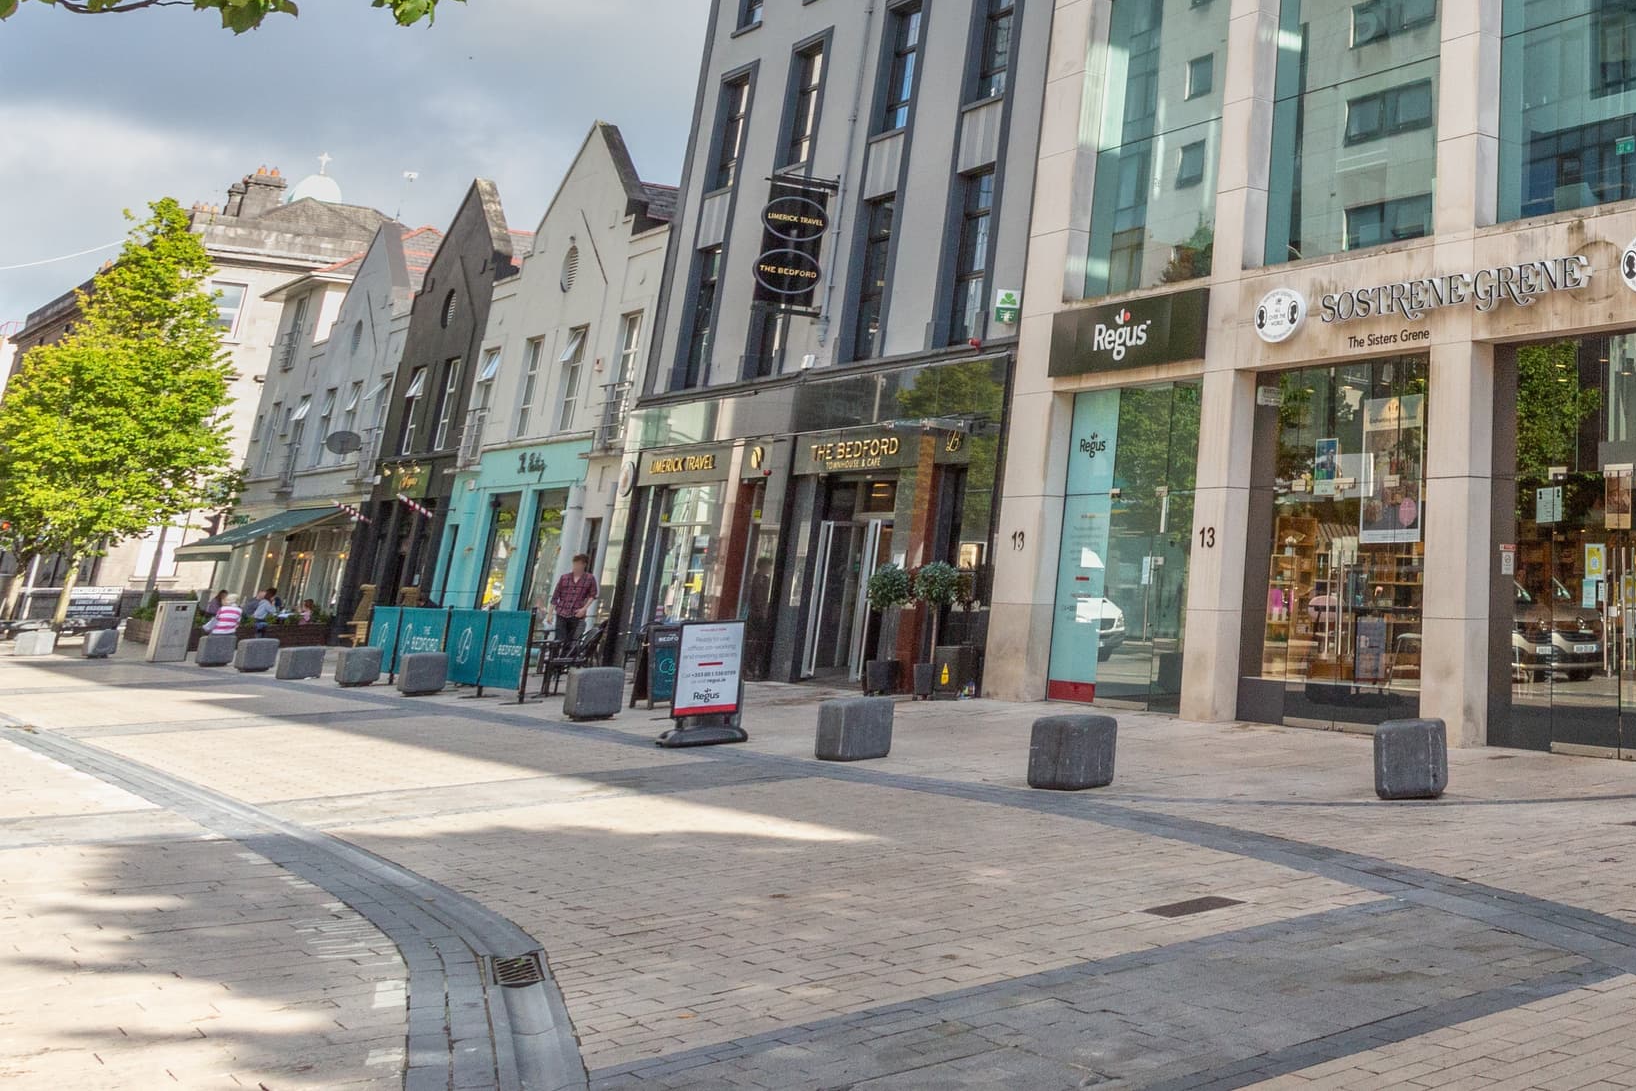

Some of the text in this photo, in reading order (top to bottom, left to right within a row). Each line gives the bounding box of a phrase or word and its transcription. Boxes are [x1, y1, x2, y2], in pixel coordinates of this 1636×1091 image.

[768, 212, 823, 226] LIMERICK TRAVEL
[760, 264, 817, 279] THE BEDFORD
[1474, 255, 1591, 311] GRENE
[1093, 322, 1148, 361] Regus
[1348, 328, 1430, 349] The Sisters Grene
[811, 437, 899, 461] THE BEDFORD
[1080, 438, 1106, 458] Regus
[650, 454, 715, 475] LIMERICK TRAVEL
[826, 459, 859, 470] TOWNHOUSE
[1011, 531, 1024, 551] 13
[1200, 526, 1215, 548] 13
[411, 636, 439, 652] BEDFORD
[498, 644, 523, 657] BEDFORD
[693, 691, 720, 703] Regus
